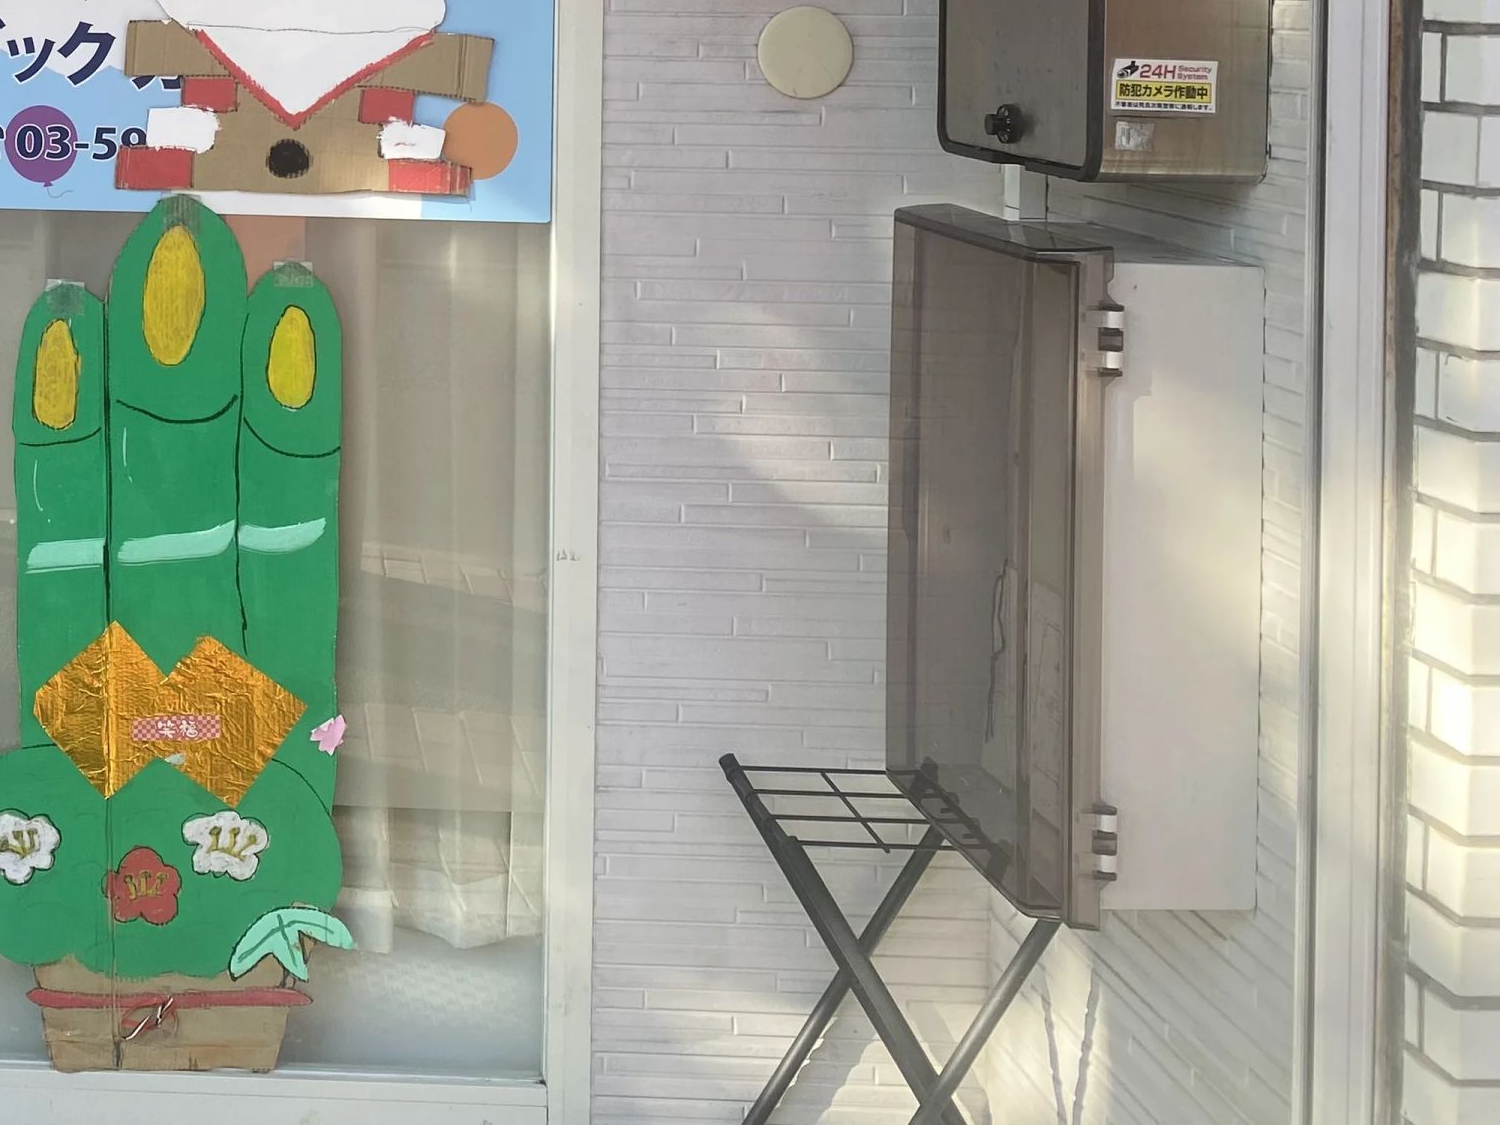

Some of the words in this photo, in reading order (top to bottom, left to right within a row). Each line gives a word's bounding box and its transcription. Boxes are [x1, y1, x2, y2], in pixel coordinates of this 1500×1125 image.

[1139, 64, 1176, 79] 24H
[1178, 65, 1213, 74] Security
[1177, 73, 1208, 81] System
[1118, 83, 1208, 99] 防犯カメラ作動中
